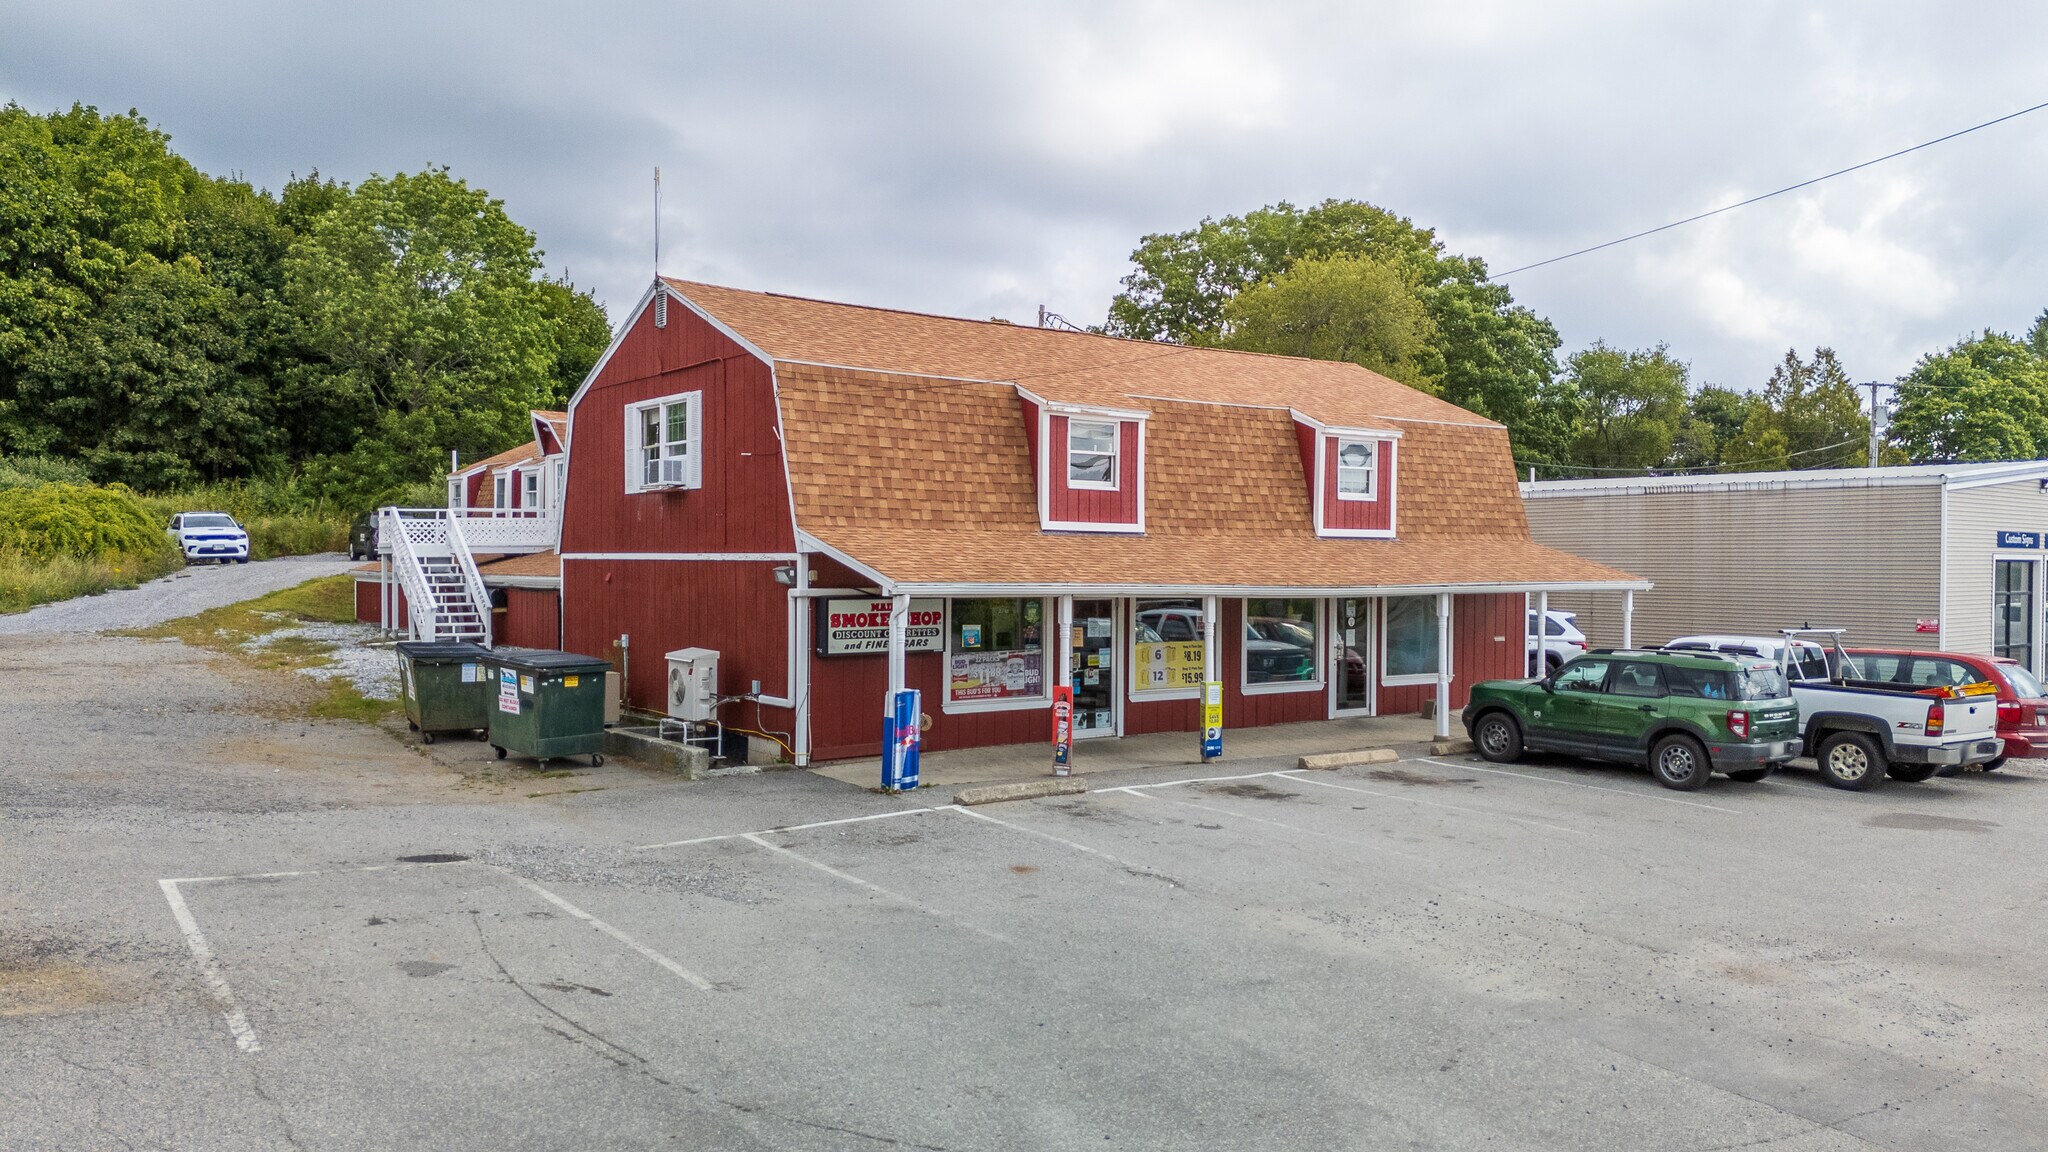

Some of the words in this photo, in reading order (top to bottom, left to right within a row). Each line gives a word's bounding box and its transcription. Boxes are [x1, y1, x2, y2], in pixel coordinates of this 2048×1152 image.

[2005, 533, 2021, 543] Custom
[2022, 534, 2033, 547] Signs
[830, 613, 890, 628] SMOKE
[908, 611, 941, 626] HOP
[836, 630, 881, 639] DISCOUNT
[884, 628, 938, 638] CRETTES
[844, 641, 862, 649] and
[865, 641, 888, 649] FINE
[1155, 650, 1162, 660] 6
[1184, 650, 1202, 662] $8.19
[1153, 671, 1164, 681] 12
[1182, 672, 1204, 684] $15.99
